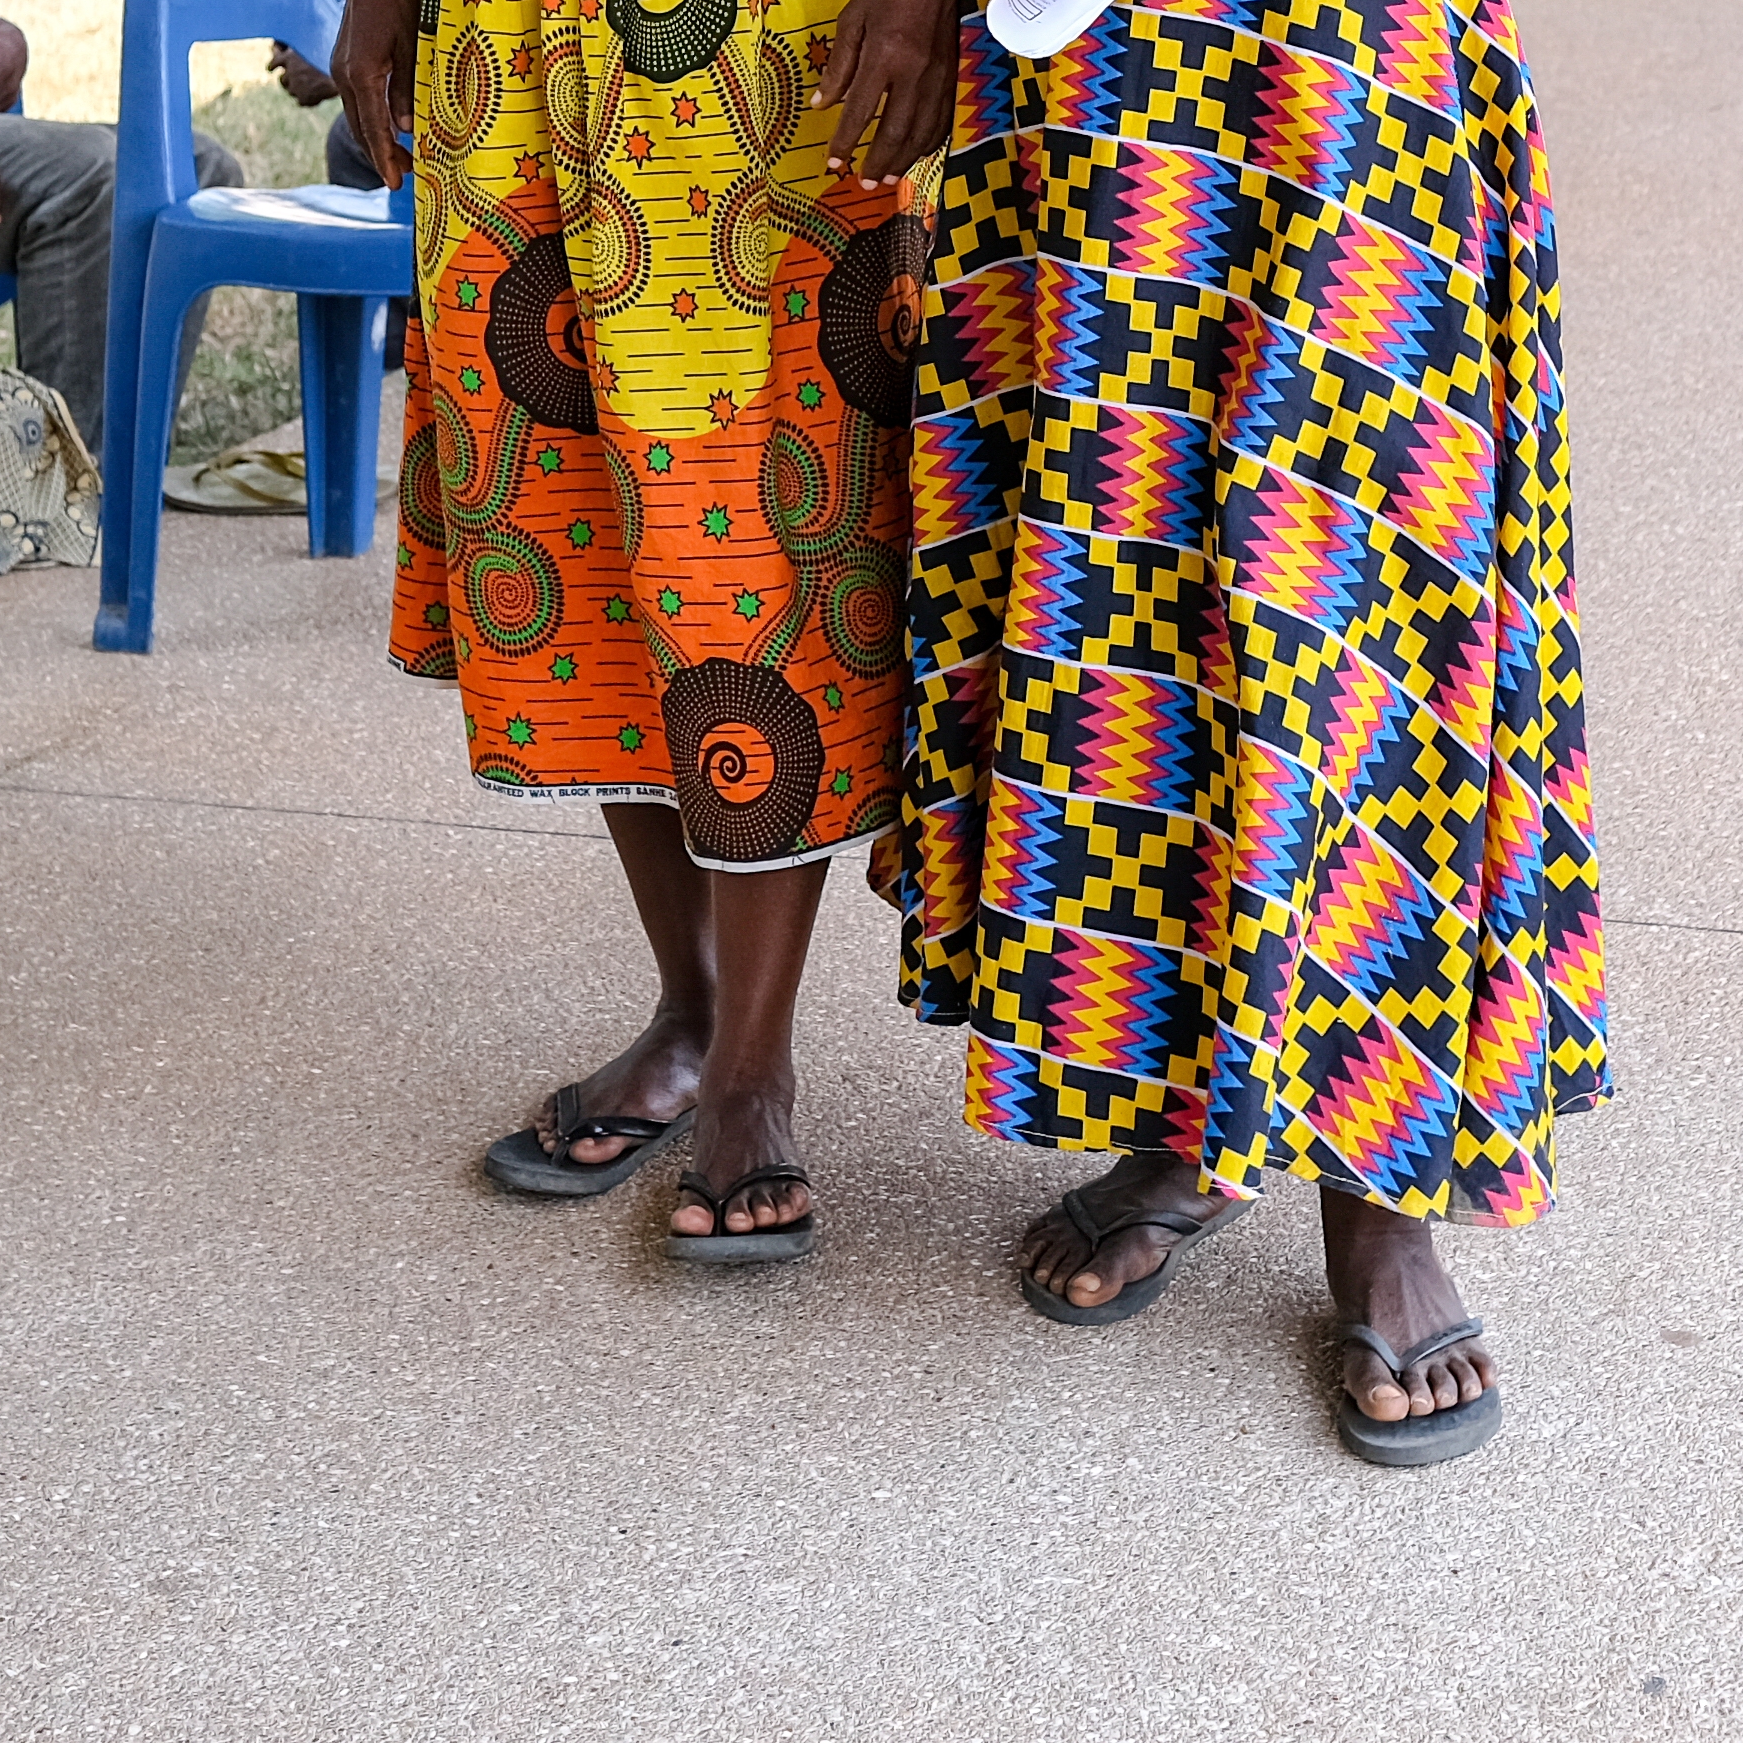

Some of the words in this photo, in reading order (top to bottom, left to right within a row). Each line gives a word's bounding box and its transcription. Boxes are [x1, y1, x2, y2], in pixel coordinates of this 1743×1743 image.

[529, 788, 554, 798] WAX
[558, 787, 591, 797] BLOCK
[596, 786, 631, 796] PRINTS
